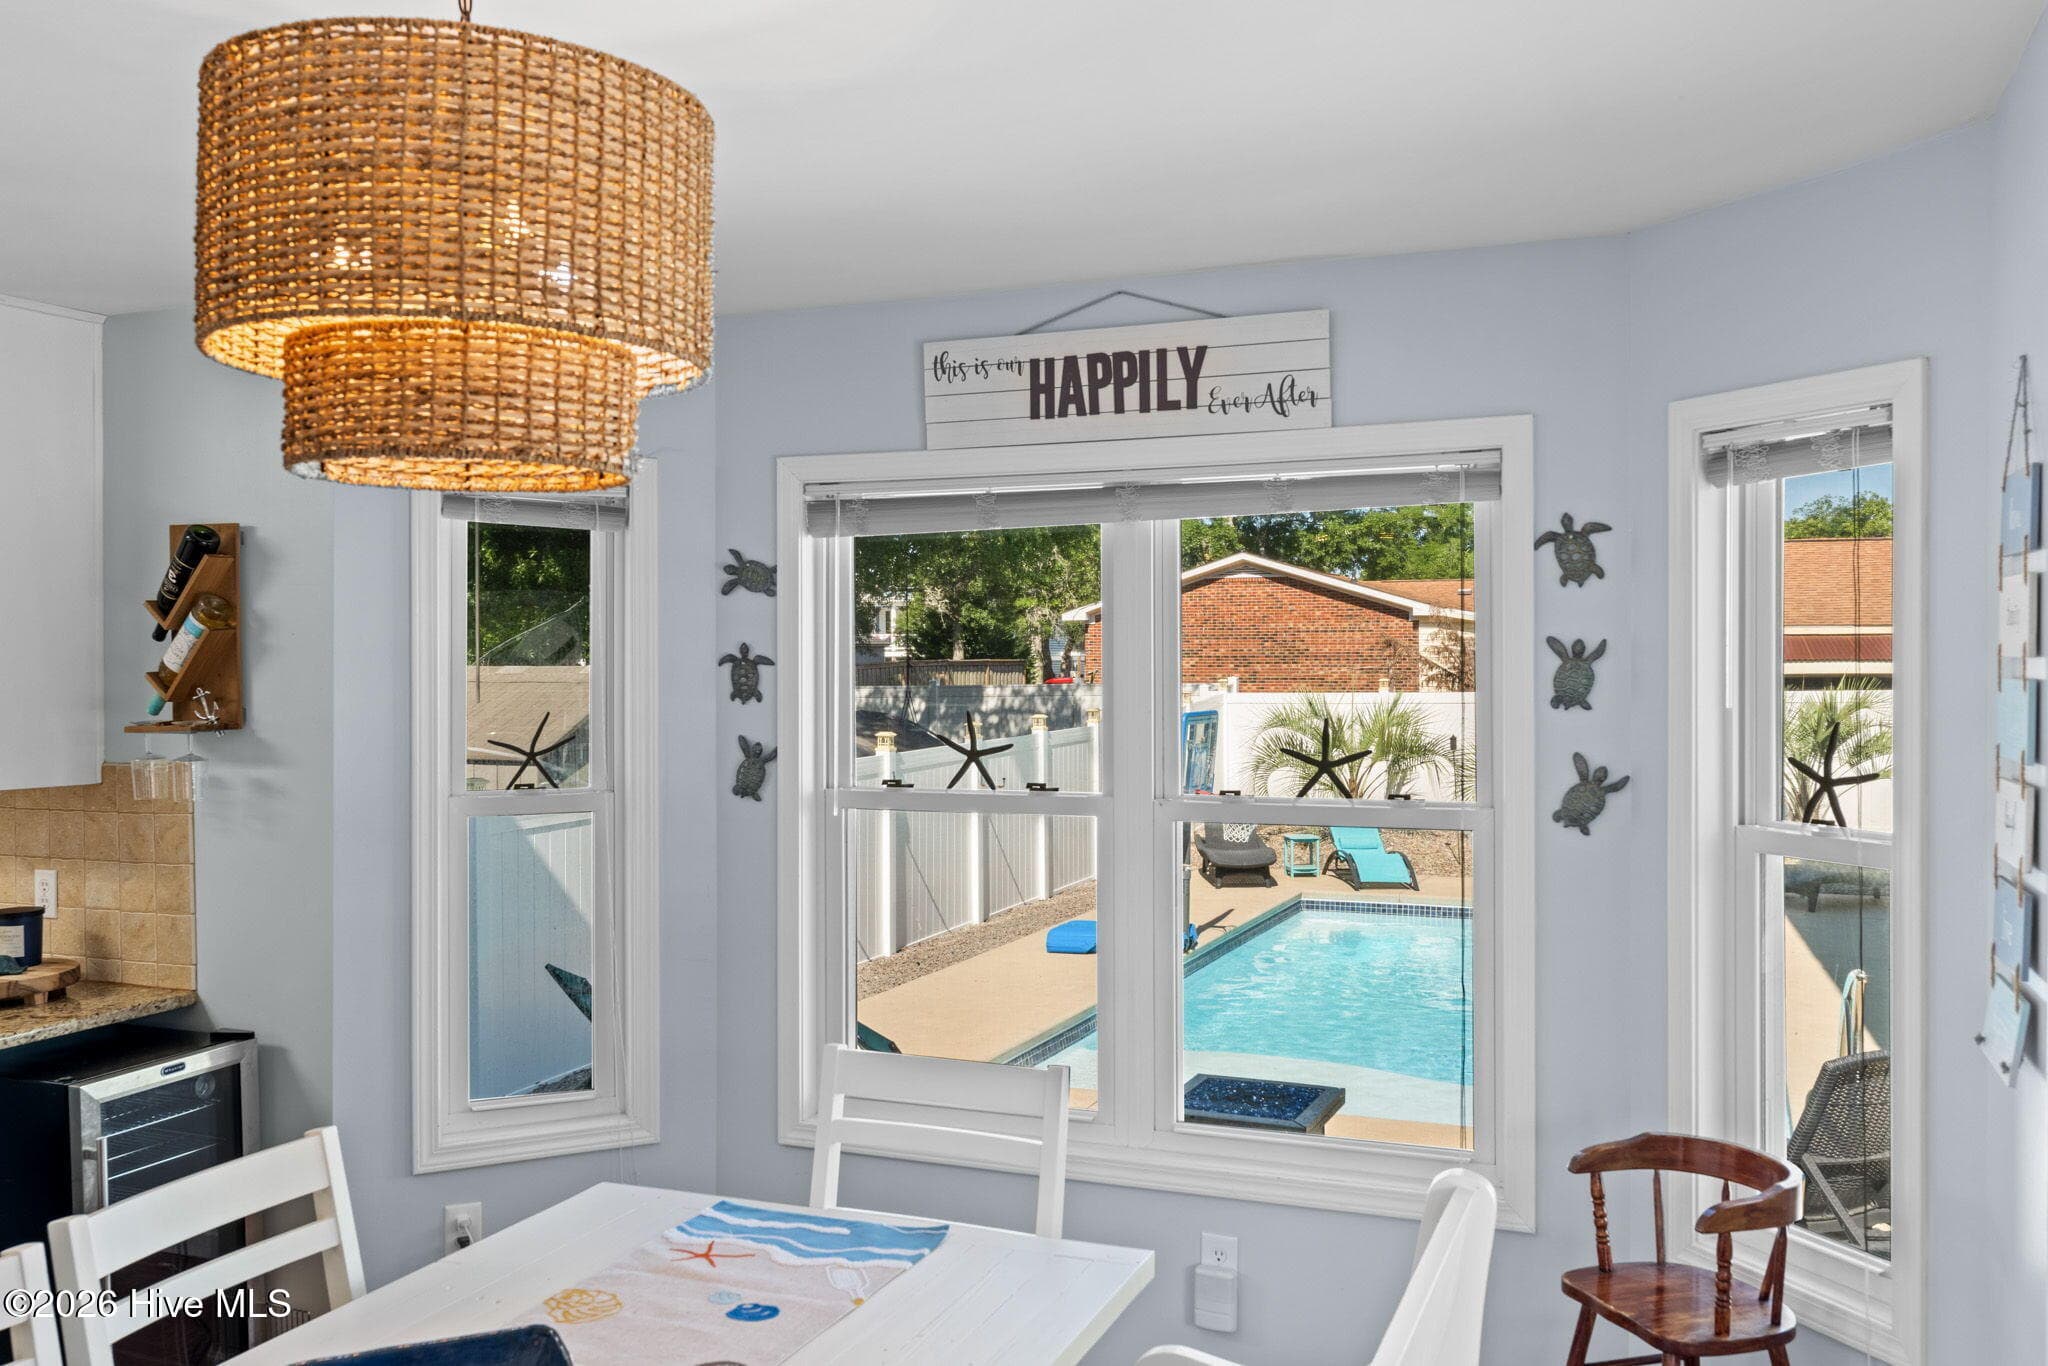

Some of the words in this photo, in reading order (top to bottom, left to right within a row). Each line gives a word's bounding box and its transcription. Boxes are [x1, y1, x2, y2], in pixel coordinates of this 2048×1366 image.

[933, 351, 968, 383] this
[974, 357, 989, 379] is
[997, 356, 1024, 376] our
[1029, 345, 1208, 419] HAPPILY
[1208, 386, 1252, 415] Ever
[1254, 374, 1319, 418] After
